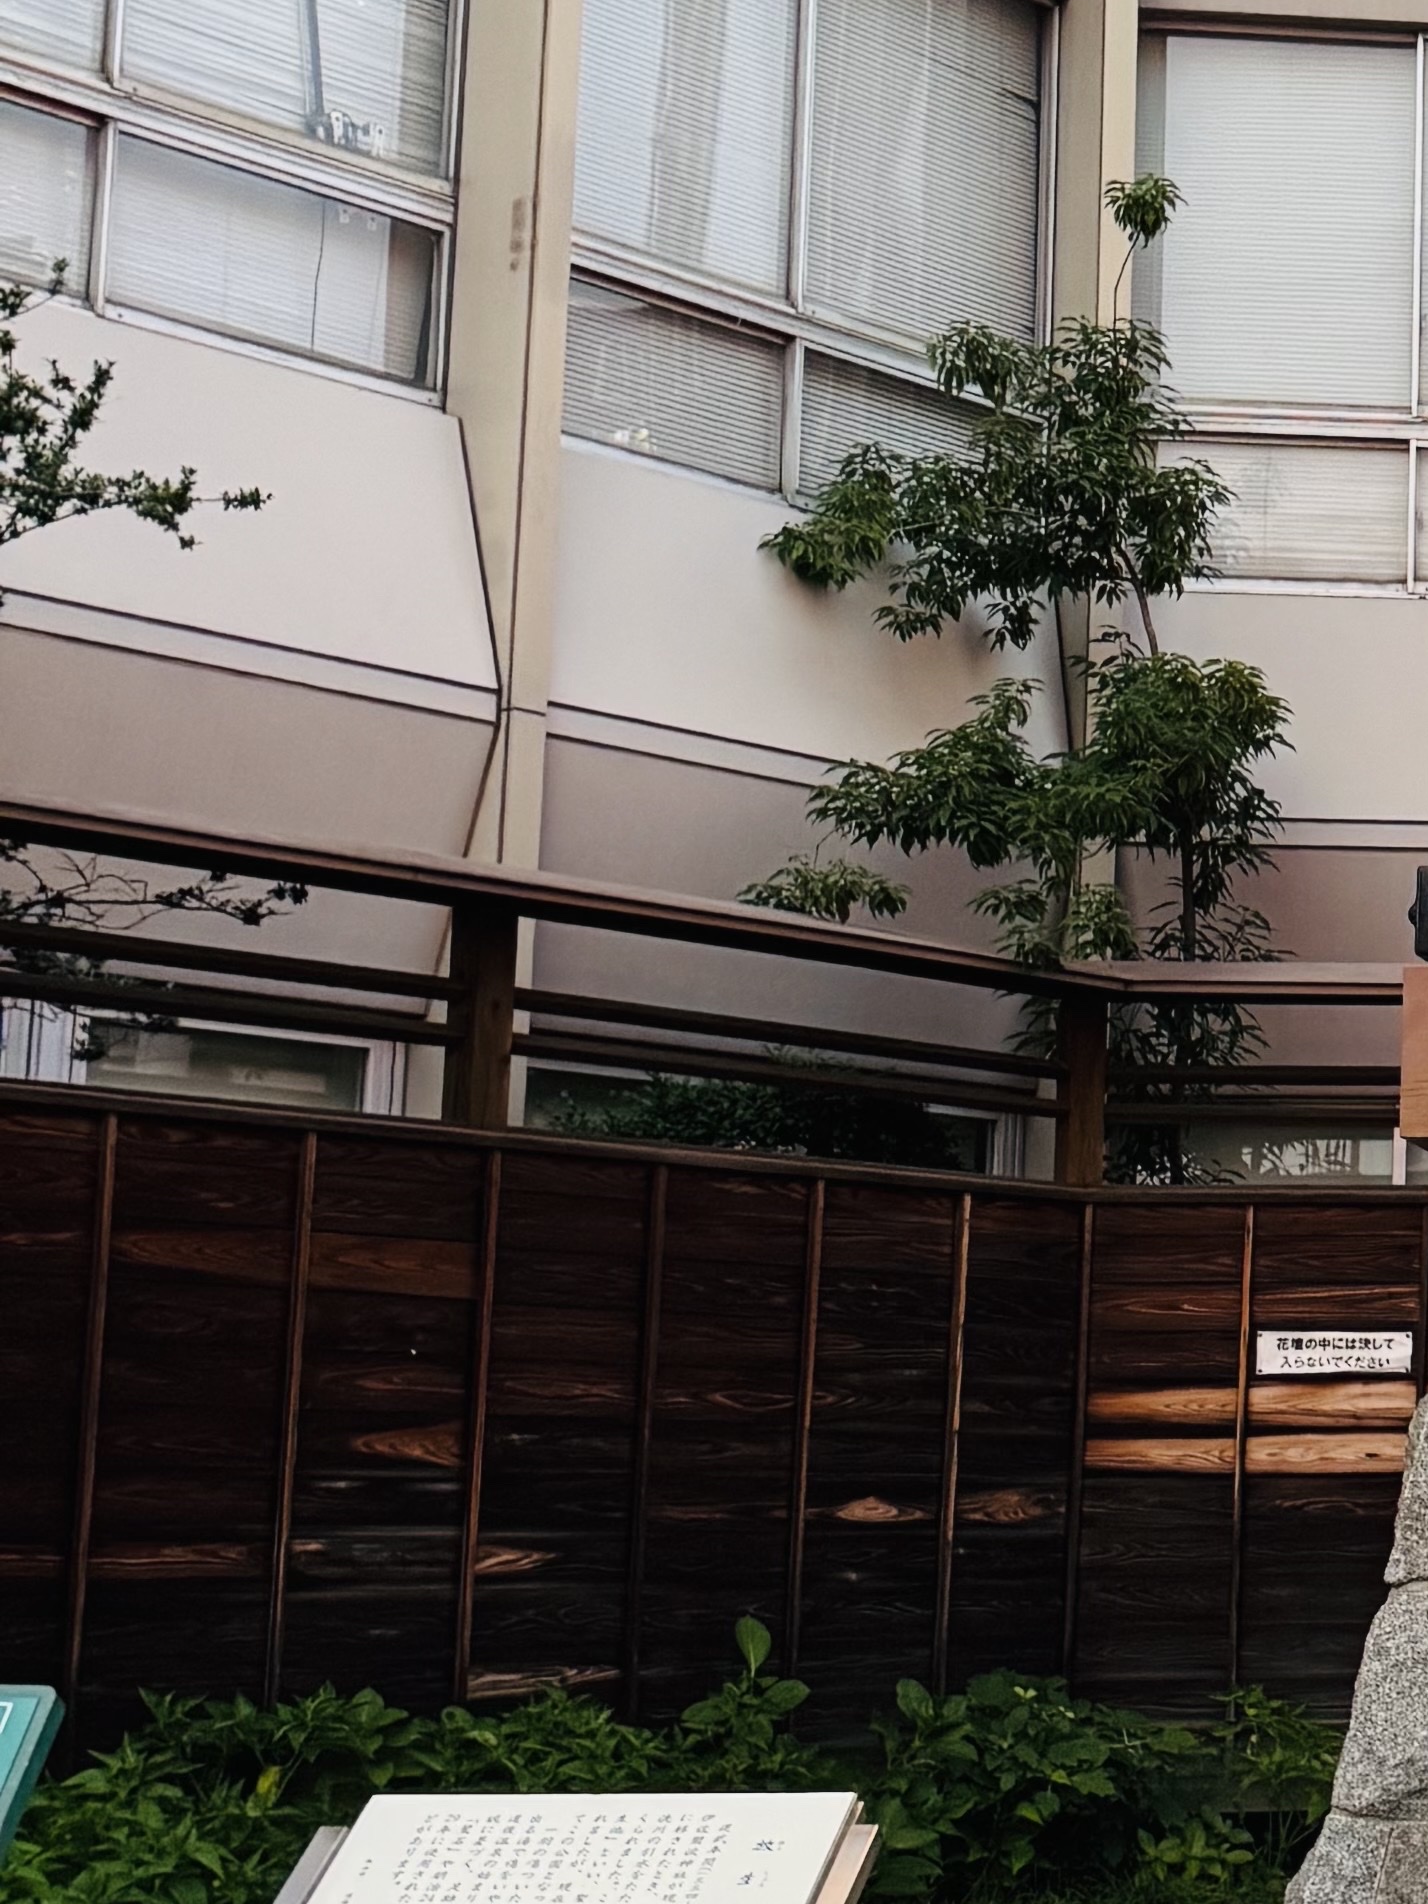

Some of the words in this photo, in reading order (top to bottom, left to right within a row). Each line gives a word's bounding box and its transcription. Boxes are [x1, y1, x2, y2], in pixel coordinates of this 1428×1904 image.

[1276, 1337, 1395, 1352] 花壇の中には決して
[1280, 1356, 1391, 1369] 入らないでください
